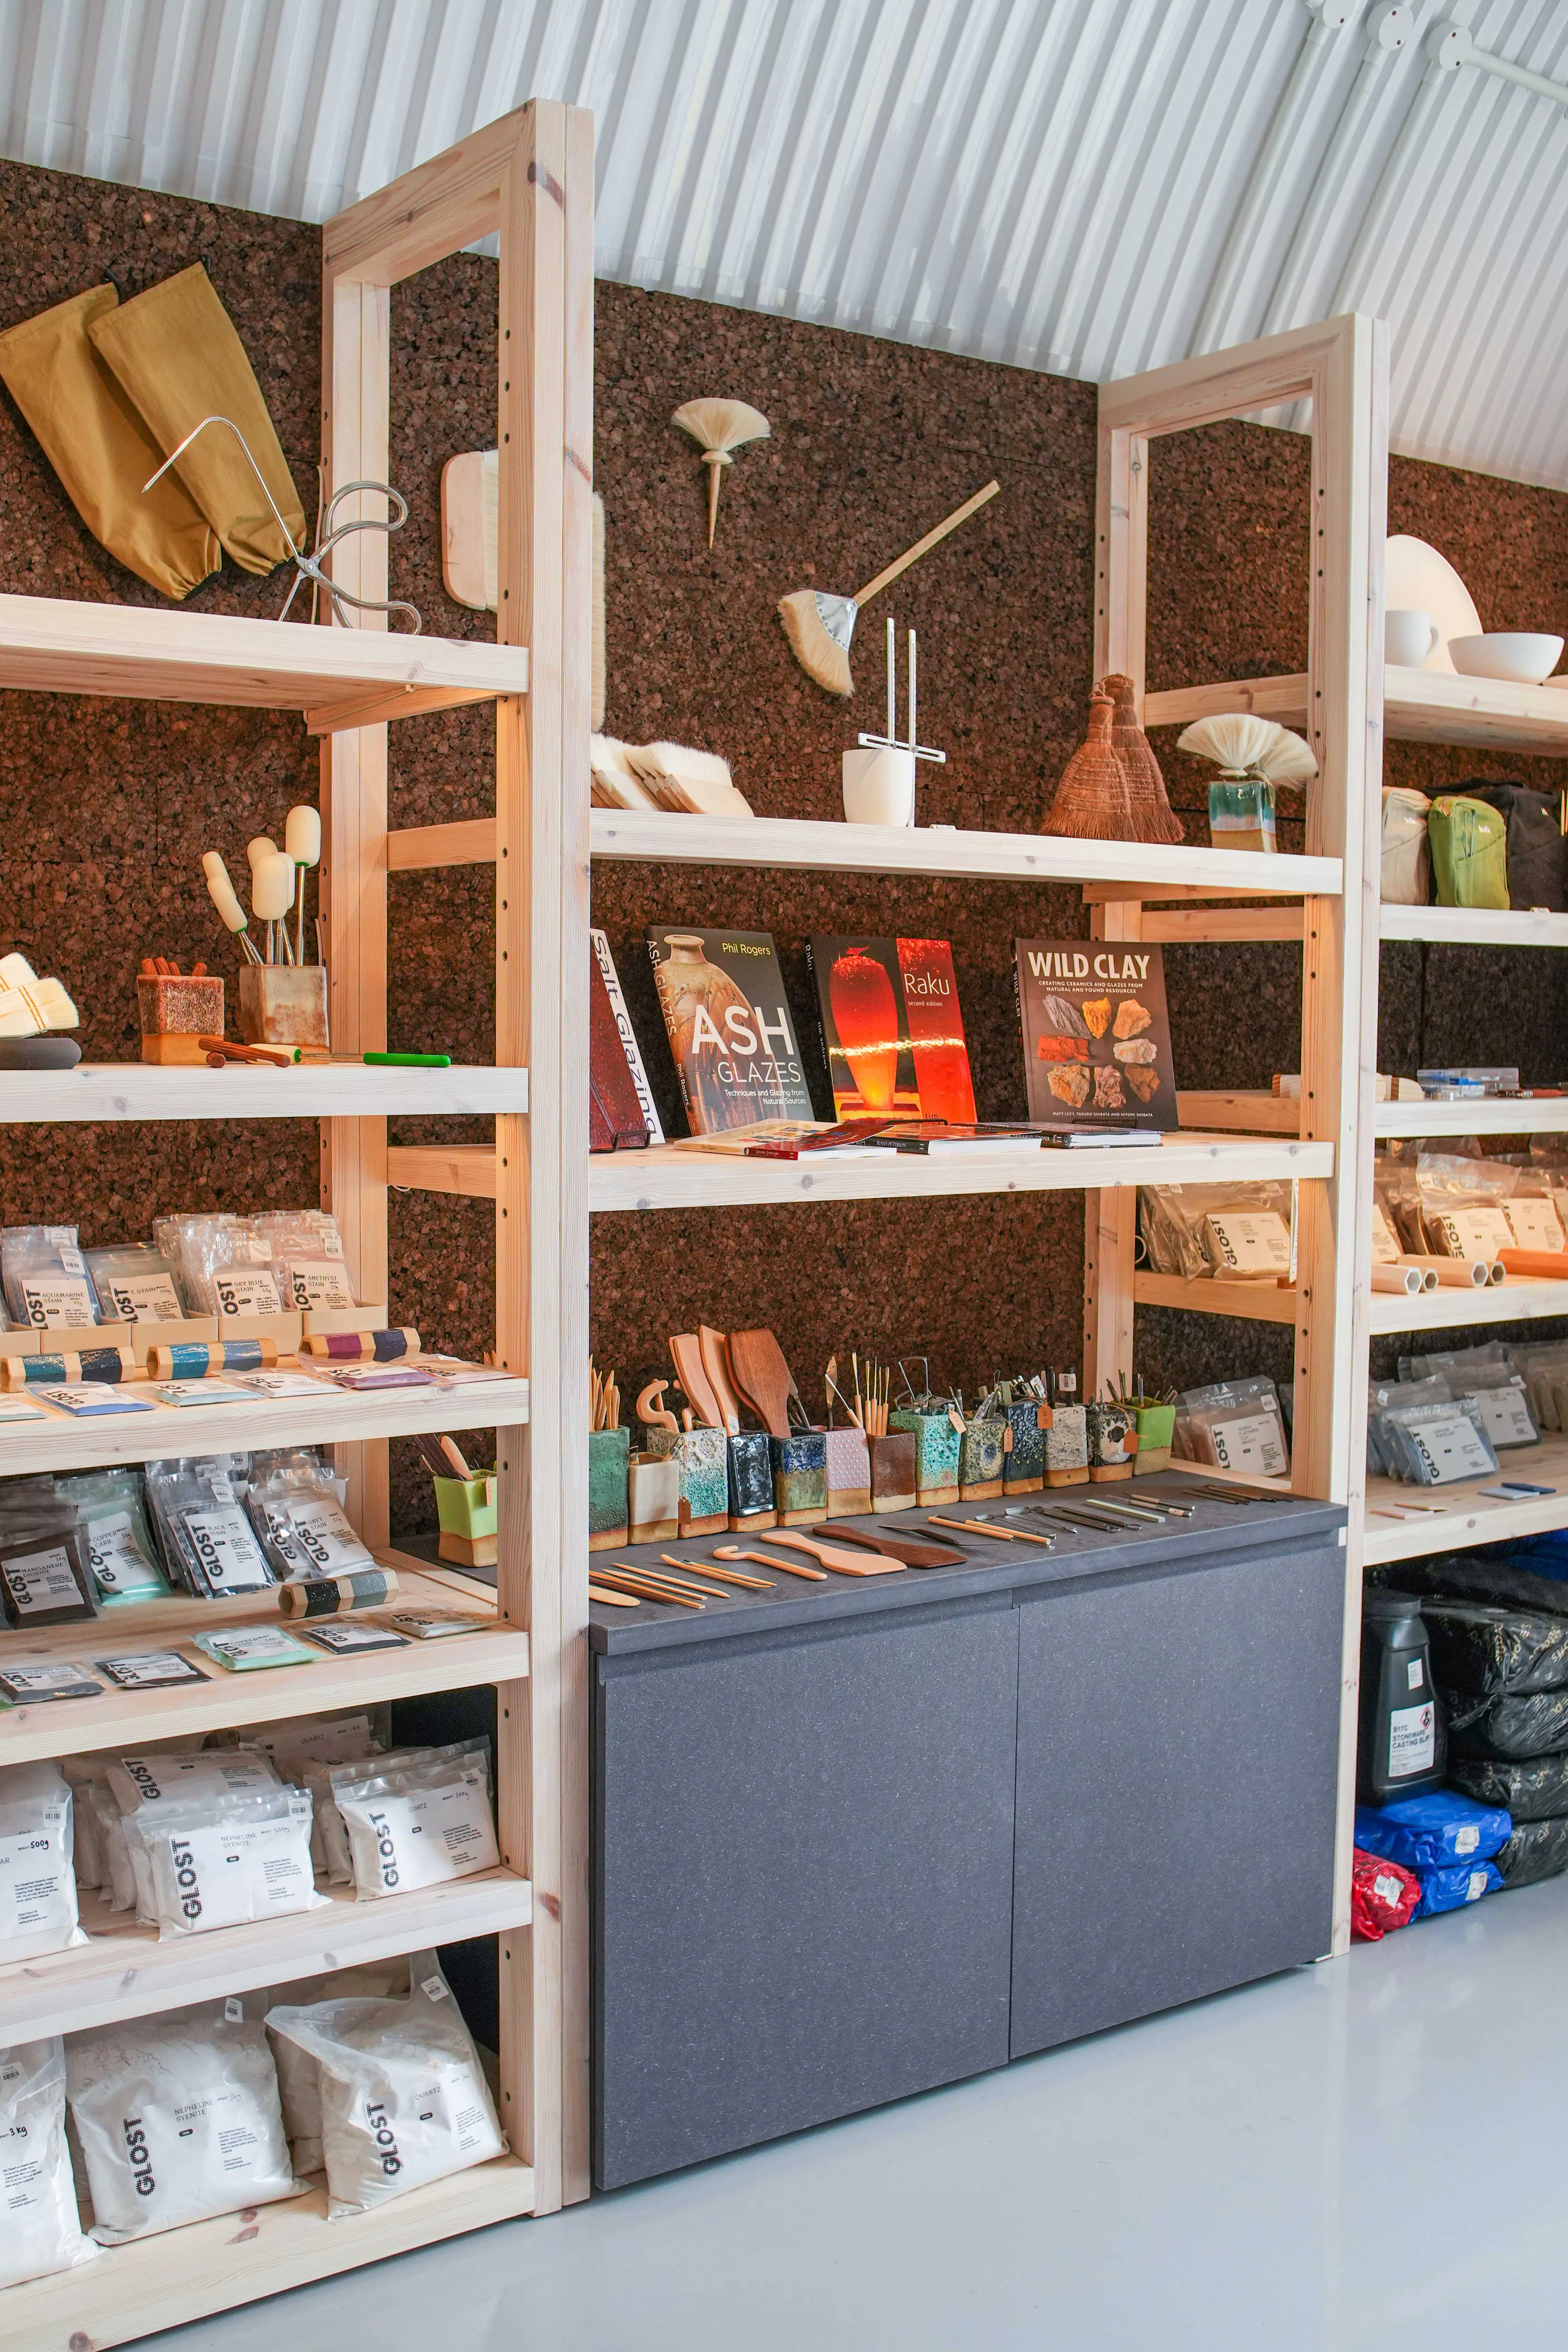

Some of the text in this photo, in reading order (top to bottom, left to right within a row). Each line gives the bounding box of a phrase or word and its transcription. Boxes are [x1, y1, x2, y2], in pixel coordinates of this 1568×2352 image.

[722, 943, 771, 956] Phil Rogers
[594, 936, 618, 999] Salt
[1028, 952, 1150, 980] WILD CLAY
[646, 940, 676, 1036] ASH GLAZES
[904, 972, 950, 995] Raku
[692, 1004, 794, 1055] ASH
[717, 1062, 801, 1082] GLAZES
[680, 1080, 690, 1106] Rogers
[1210, 1219, 1237, 1265] GLOST
[114, 1287, 139, 1323] LOST
[217, 1280, 240, 1316] OST
[292, 1270, 313, 1311] LOST
[26, 1288, 49, 1330] LOST
[1214, 1430, 1231, 1469] LOST
[1411, 1430, 1440, 1479] GLOST
[93, 1530, 117, 1542] COPPER
[294, 1519, 330, 1562] GLOST
[310, 1522, 327, 1530] STAIN
[89, 1546, 116, 1582] GLO
[191, 1524, 224, 1577] GLOST
[21, 1563, 63, 1573] MANGANESE
[4, 1567, 33, 1604] GLOST
[301, 1734, 325, 1744] QUARTZ
[1392, 1729, 1426, 1742] STONEWARE
[1392, 1738, 1418, 1749] CASTING
[125, 1760, 162, 1800] GLOST
[455, 1792, 470, 1800] 500g
[408, 1803, 427, 1813] QUARTZ
[31, 1840, 49, 1850] 500g
[221, 1833, 257, 1841] NEPHELINE
[368, 1812, 400, 1888] GLOST
[171, 1839, 203, 1919] GLOST
[174, 2099, 214, 2115] NEPHELINE
[414, 2087, 441, 2100] QUARTZ
[9, 2126, 27, 2137] 3 kg
[176, 2109, 206, 2123] SYENITE
[366, 2103, 403, 2176] GLOST
[123, 2118, 157, 2197] GLOST
